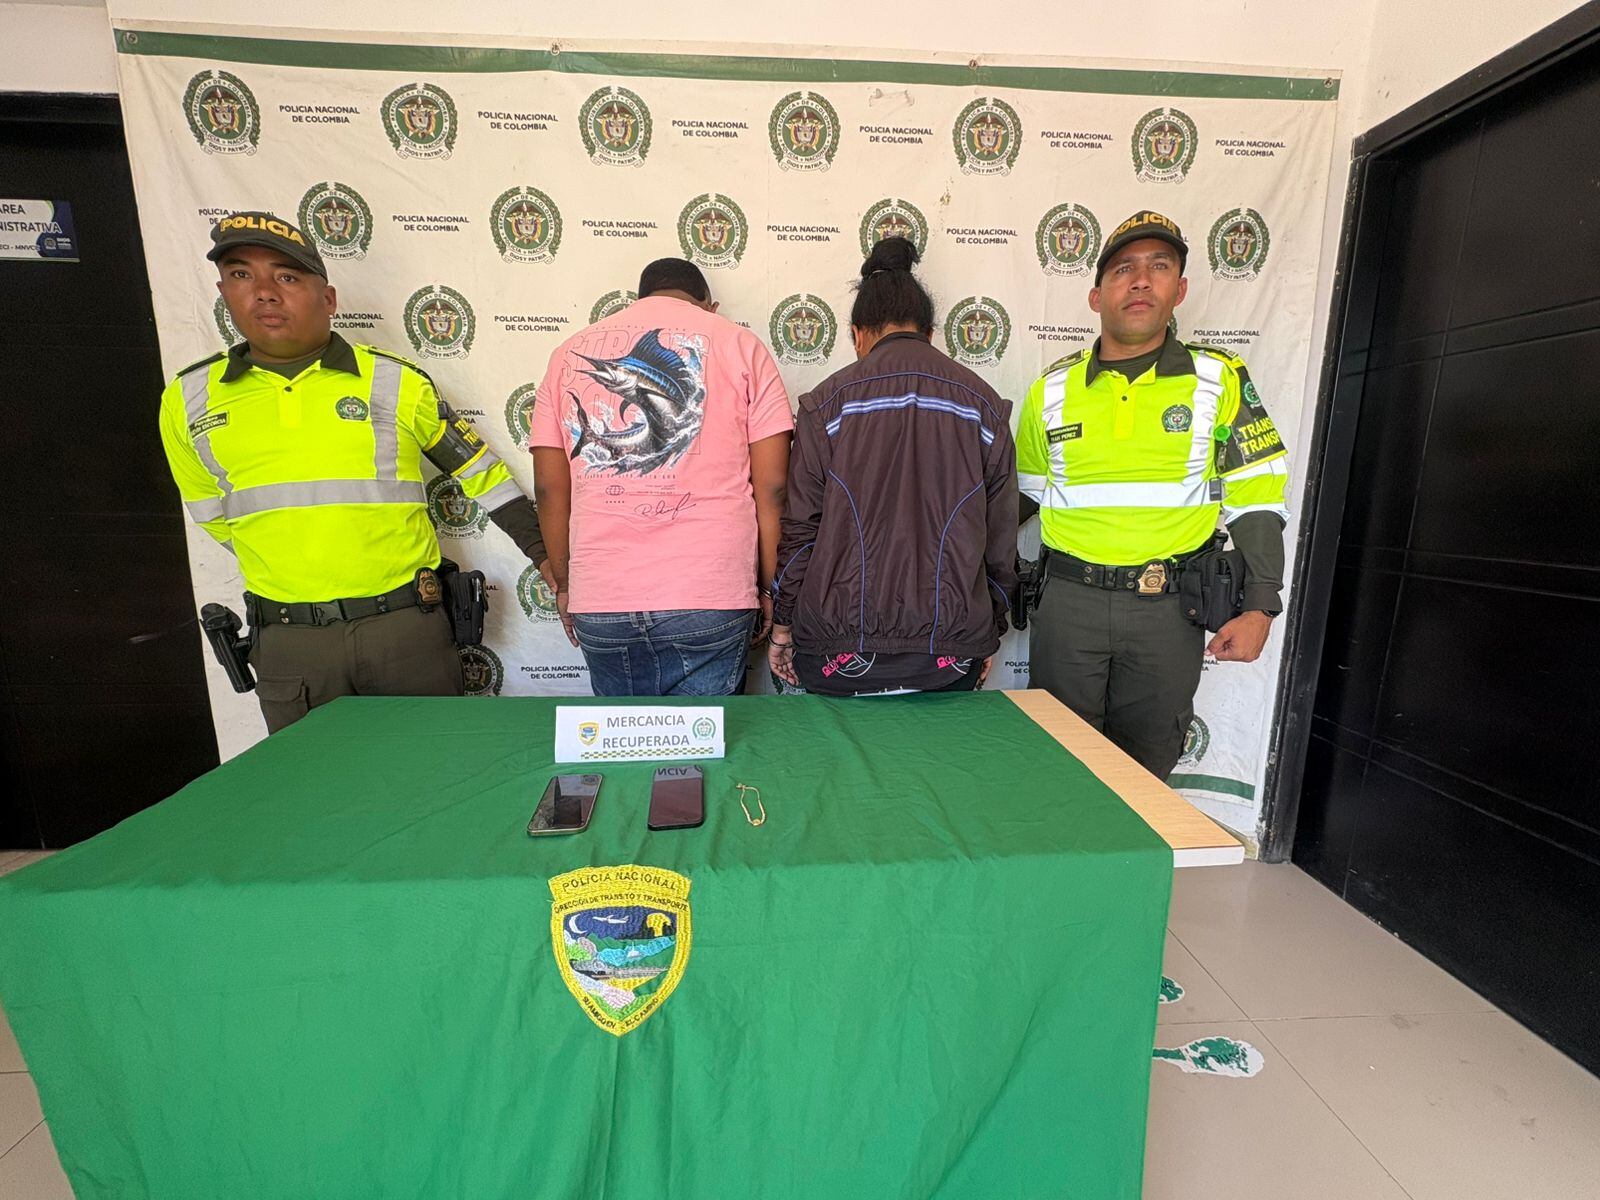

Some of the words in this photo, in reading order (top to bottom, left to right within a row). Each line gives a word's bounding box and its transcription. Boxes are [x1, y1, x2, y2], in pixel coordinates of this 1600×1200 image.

[279, 105, 314, 113] POLICIA
[315, 106, 360, 114] NACIONAL
[292, 115, 303, 123] DE
[305, 115, 350, 123] COLOMBIA
[478, 111, 512, 120] POLICIA
[514, 113, 558, 122] NACIONAL
[503, 122, 548, 130] COLOMBIA
[672, 120, 705, 128] POLICIA
[706, 121, 749, 129] NACIONAL
[695, 130, 738, 138] COLOMBIA
[859, 126, 891, 134] POLICIA
[892, 127, 933, 135] NACIONAL
[869, 135, 880, 143] DE
[881, 136, 923, 144] COLOMBIA
[1041, 131, 1071, 139] POLICIA
[1073, 132, 1113, 141] NACIONAL
[1062, 141, 1103, 149] COLOMBIA
[1215, 139, 1245, 147] POLICIA
[1235, 149, 1275, 157] COLOMBIA
[198, 208, 229, 216] POLICIA
[416, 224, 460, 232] COLOMBIA
[582, 220, 615, 228] POLICIA
[616, 221, 658, 229] NACIONAL
[220, 216, 305, 247] POLICIA
[978, 229, 1018, 237] NACIONAL
[1108, 213, 1176, 246] POLICIA
[606, 230, 648, 238] COLOMBIA
[789, 234, 830, 242] COLOMBIA
[494, 315, 526, 323] POLICIA
[527, 316, 570, 324] NACIONAL
[517, 324, 560, 332] COLOMBIA
[1057, 326, 1095, 334] NACIONAL
[1048, 334, 1085, 342] COLOMBIA
[607, 714, 686, 728] MERCANCIA
[602, 735, 690, 749] RECUPERADA
[562, 873, 612, 892] POLICIA
[615, 871, 676, 890] NACIONAL
[643, 894, 689, 912] TRANSPORTE
